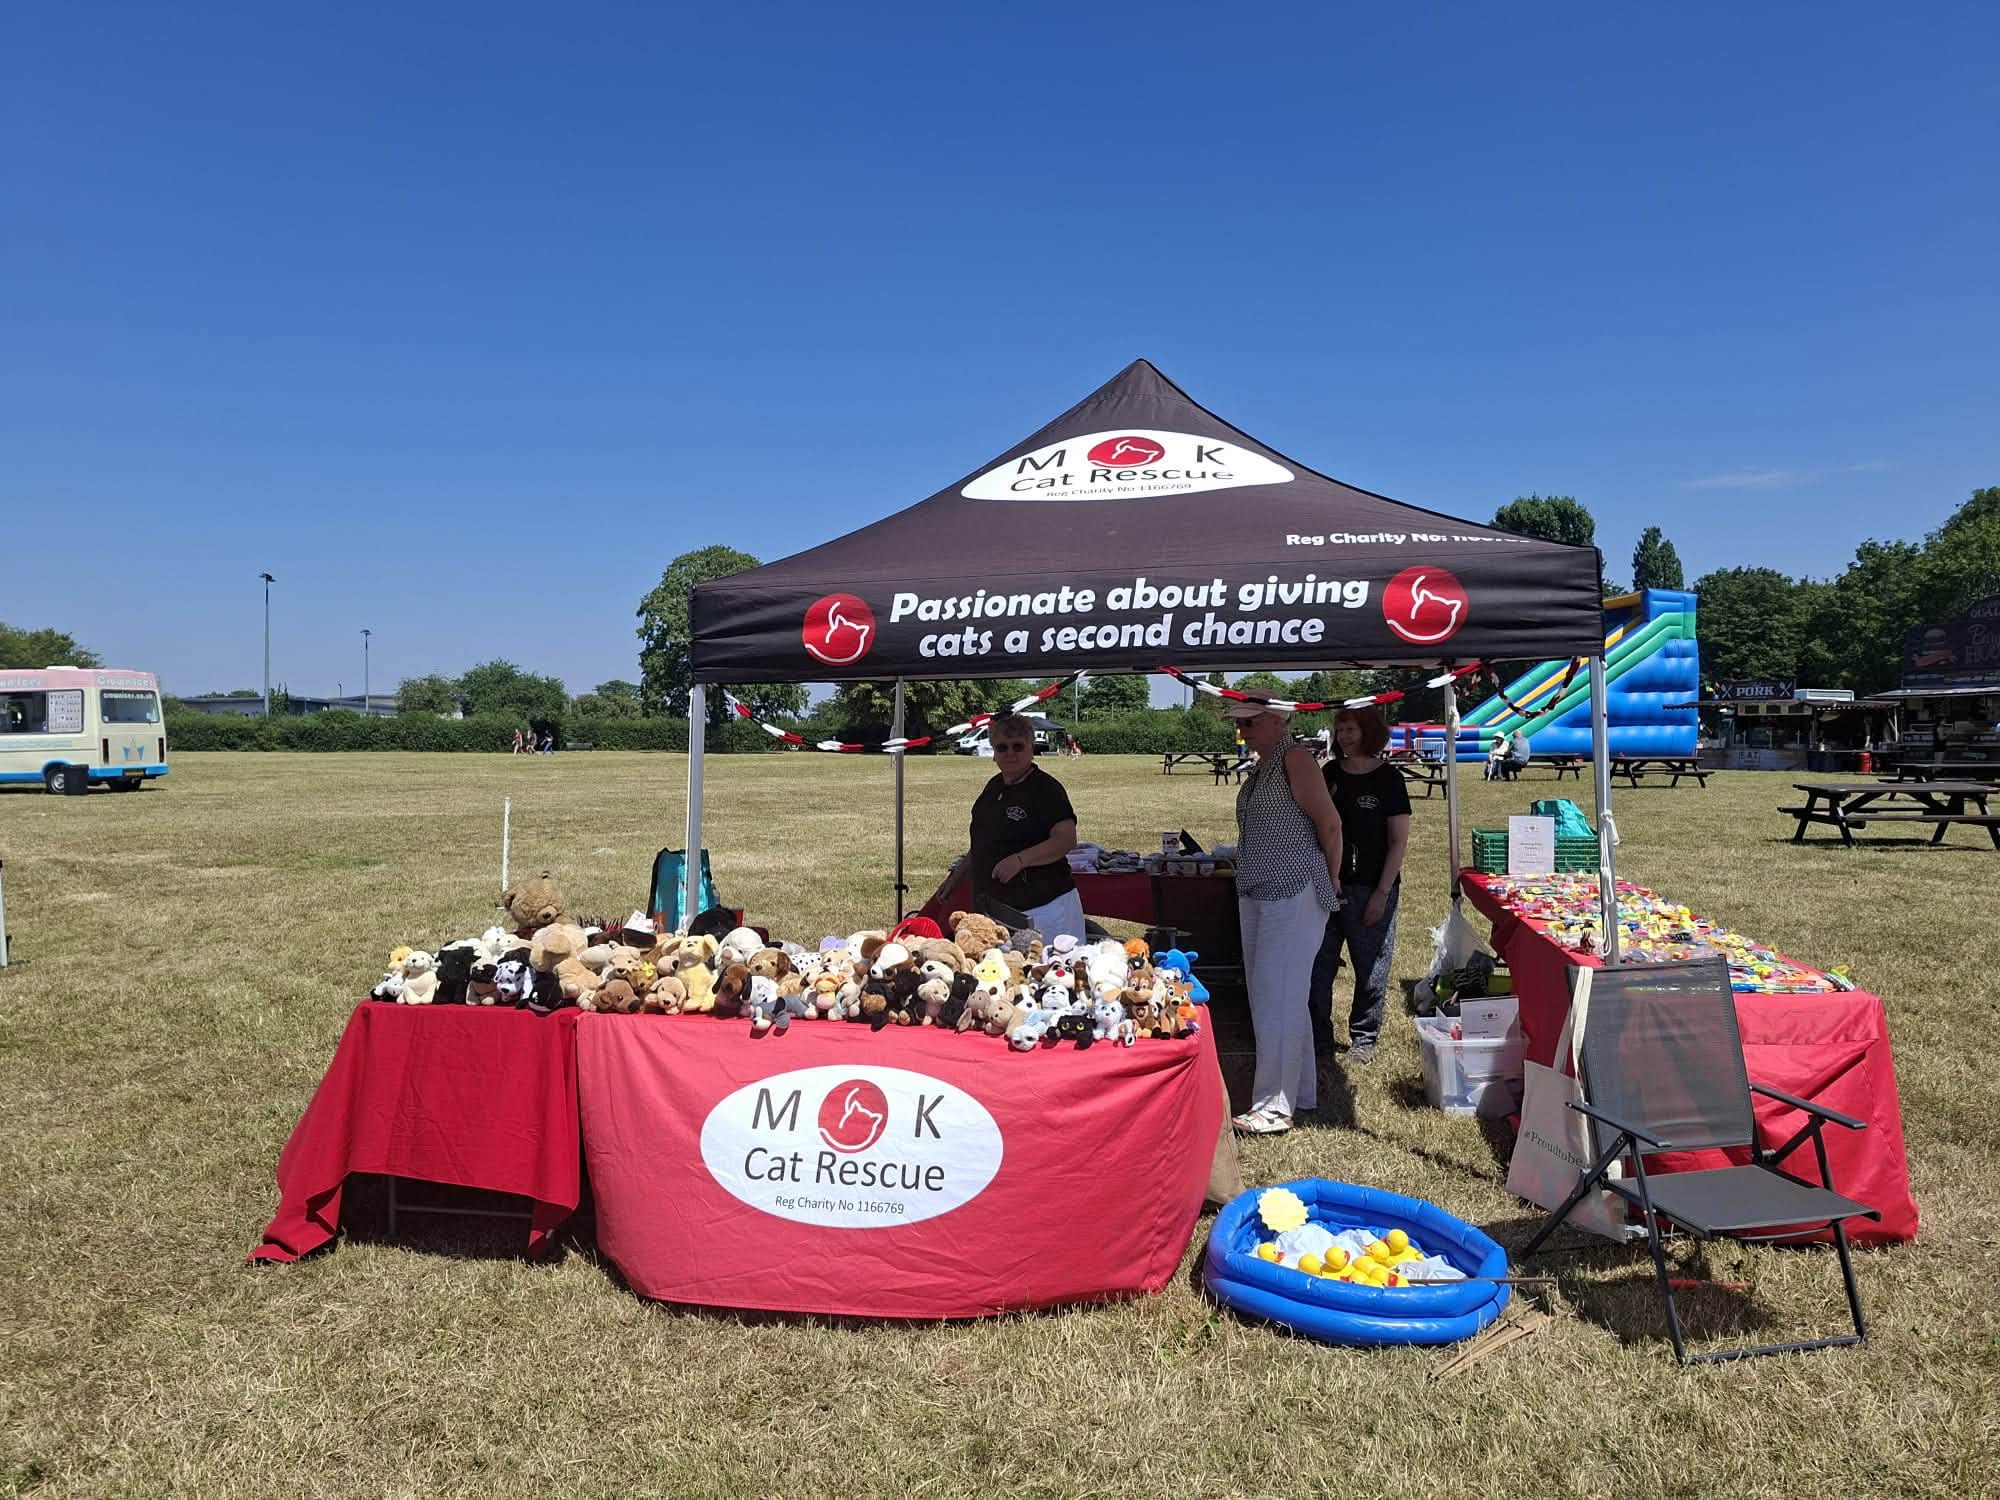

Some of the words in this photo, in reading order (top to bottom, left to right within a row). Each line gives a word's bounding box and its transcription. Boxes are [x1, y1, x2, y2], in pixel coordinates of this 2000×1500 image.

[1017, 449, 1066, 474] M
[1197, 445, 1224, 465] K
[1011, 473, 1074, 492] Cat
[1090, 468, 1234, 483] Rescue
[1286, 534, 1324, 546] Reg
[1330, 533, 1406, 545] Charity
[1412, 533, 1447, 542] No:
[889, 586, 1096, 622] Passionate
[1106, 577, 1227, 610] about
[1238, 574, 1369, 611] giving
[920, 626, 993, 658] cats
[1004, 630, 1029, 653] a
[1040, 613, 1173, 652] second
[1183, 612, 1325, 645] chance
[1736, 686, 1775, 697] PORK
[752, 1088, 801, 1131] M
[914, 1094, 945, 1139] K
[1524, 1130, 1586, 1168] #Proudtobe
[744, 1147, 803, 1182] Cat
[815, 1151, 945, 1191] Rescue
[775, 1196, 794, 1209] Reg
[798, 1197, 836, 1211] Charity
[838, 1199, 854, 1211] No
[858, 1201, 905, 1214] 1166769
